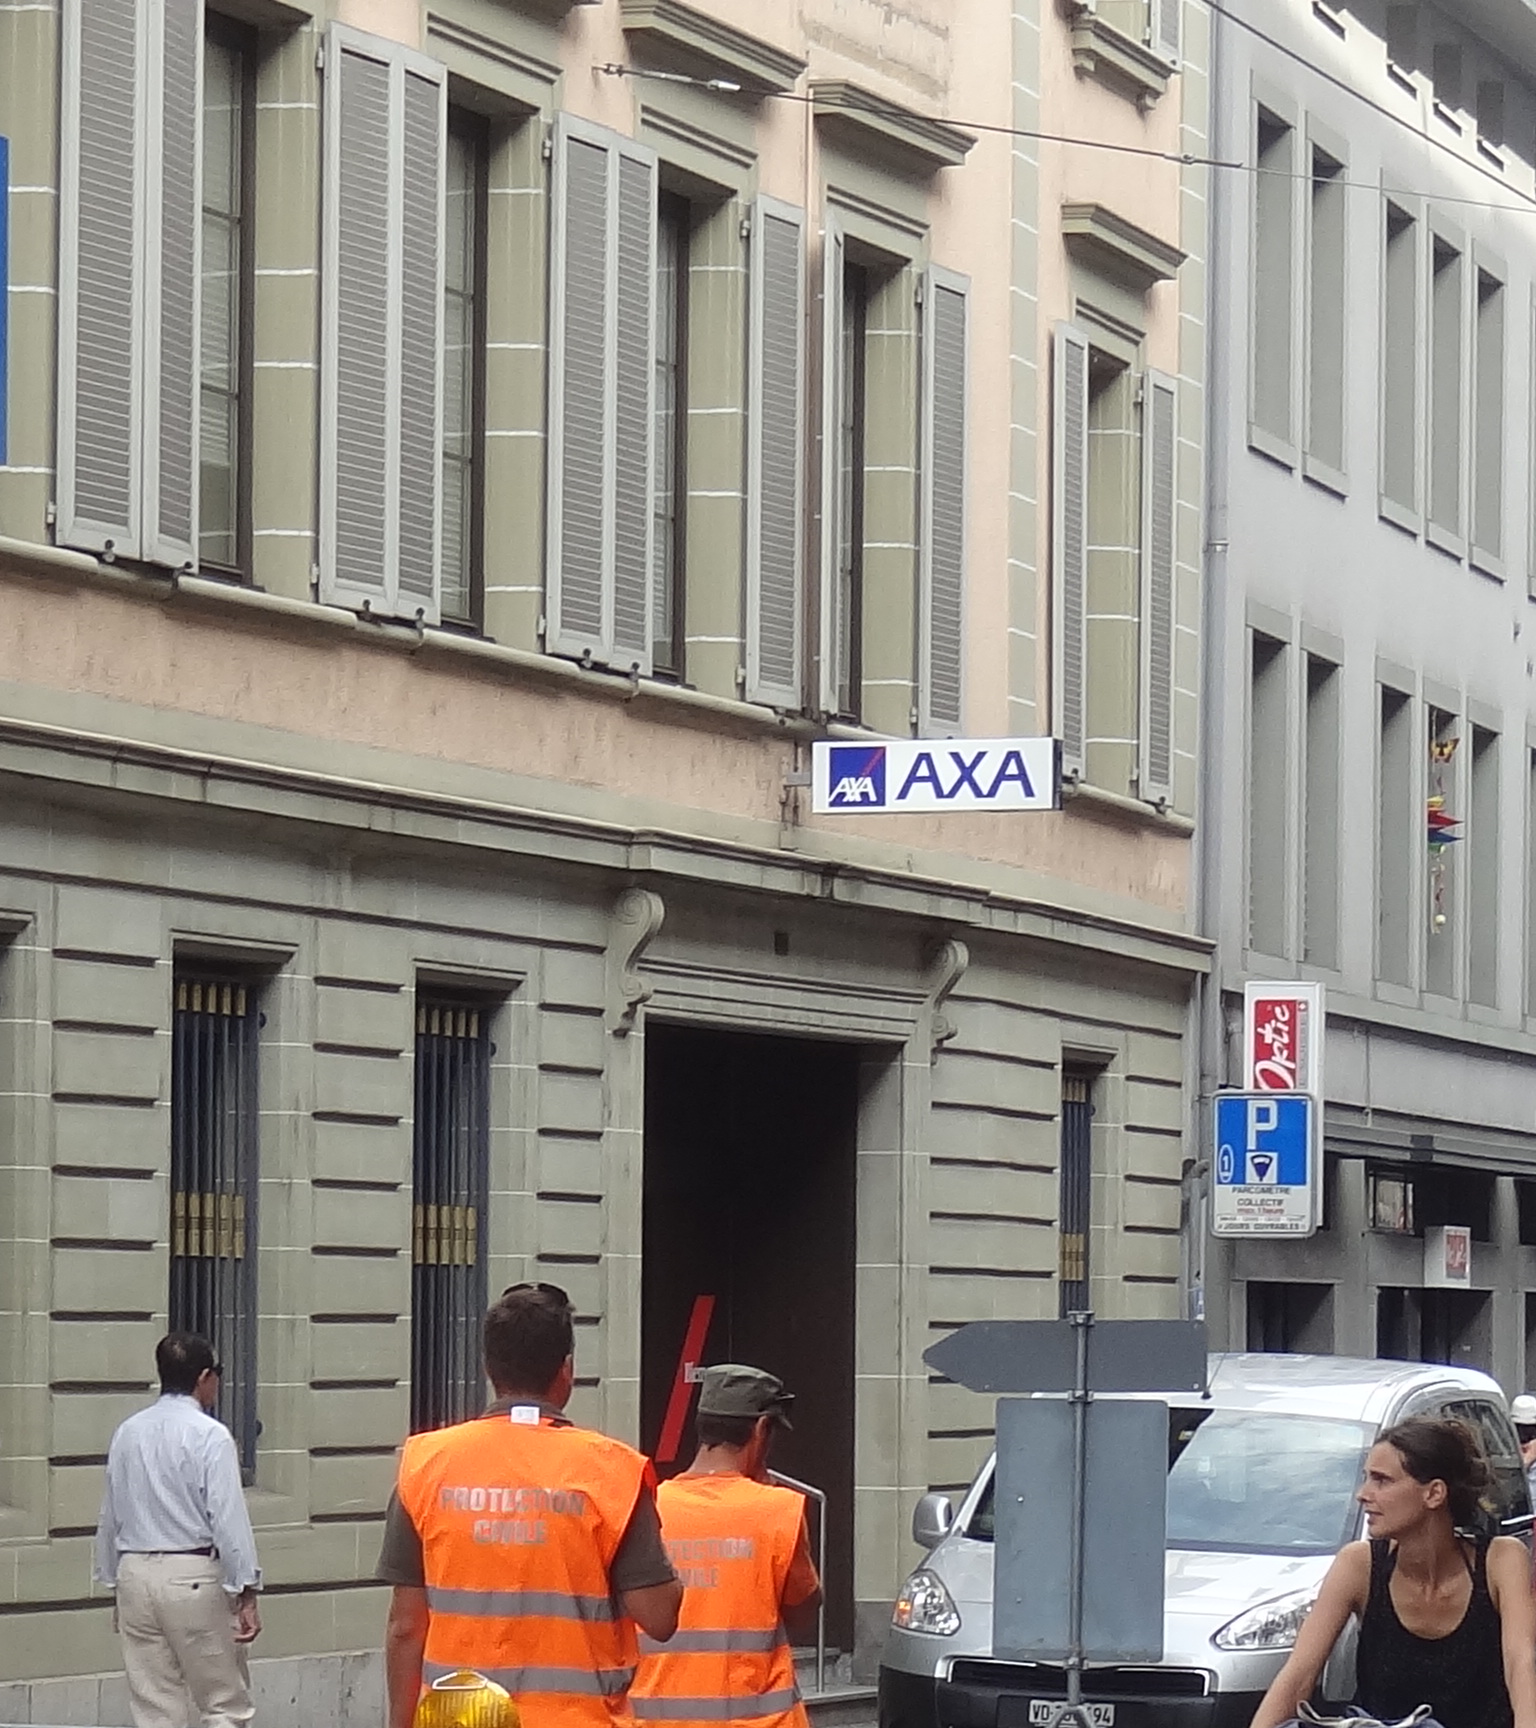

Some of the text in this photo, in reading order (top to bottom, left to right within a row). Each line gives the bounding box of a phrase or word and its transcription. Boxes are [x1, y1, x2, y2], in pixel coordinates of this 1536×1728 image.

[895, 750, 1036, 800] AXA
[830, 777, 877, 802] AXA
[1255, 1004, 1296, 1089] Optic
[1247, 1099, 1278, 1150] P
[440, 1487, 585, 1515] PROTECTION
[474, 1520, 546, 1543] CIVILE
[667, 1539, 753, 1559] TECTION
